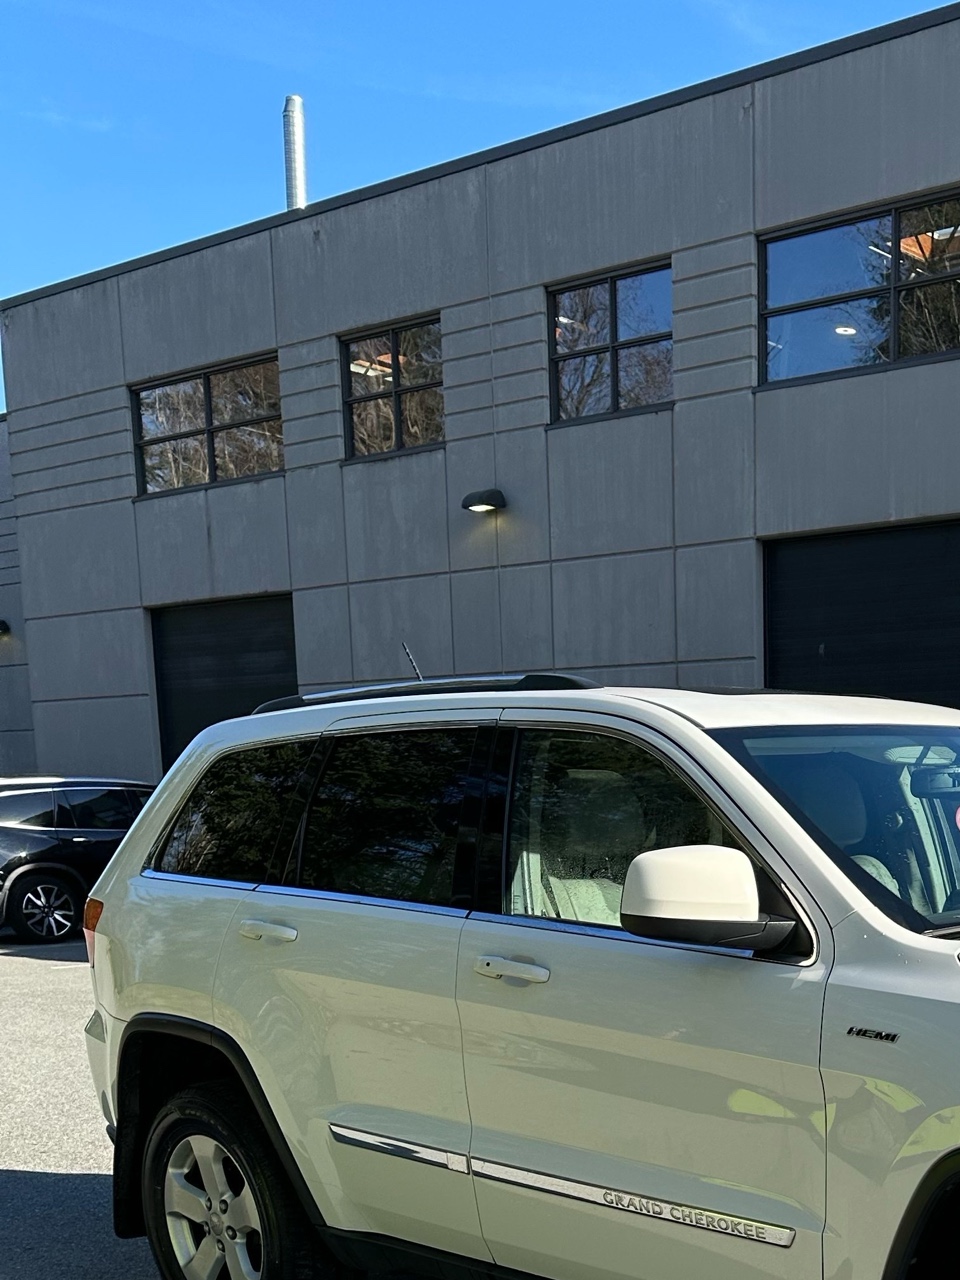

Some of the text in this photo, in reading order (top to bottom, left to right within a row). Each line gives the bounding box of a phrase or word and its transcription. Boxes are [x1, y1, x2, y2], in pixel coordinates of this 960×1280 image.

[846, 1026, 900, 1043] HEMI
[602, 1190, 767, 1240] GRAND CHEROKEE
